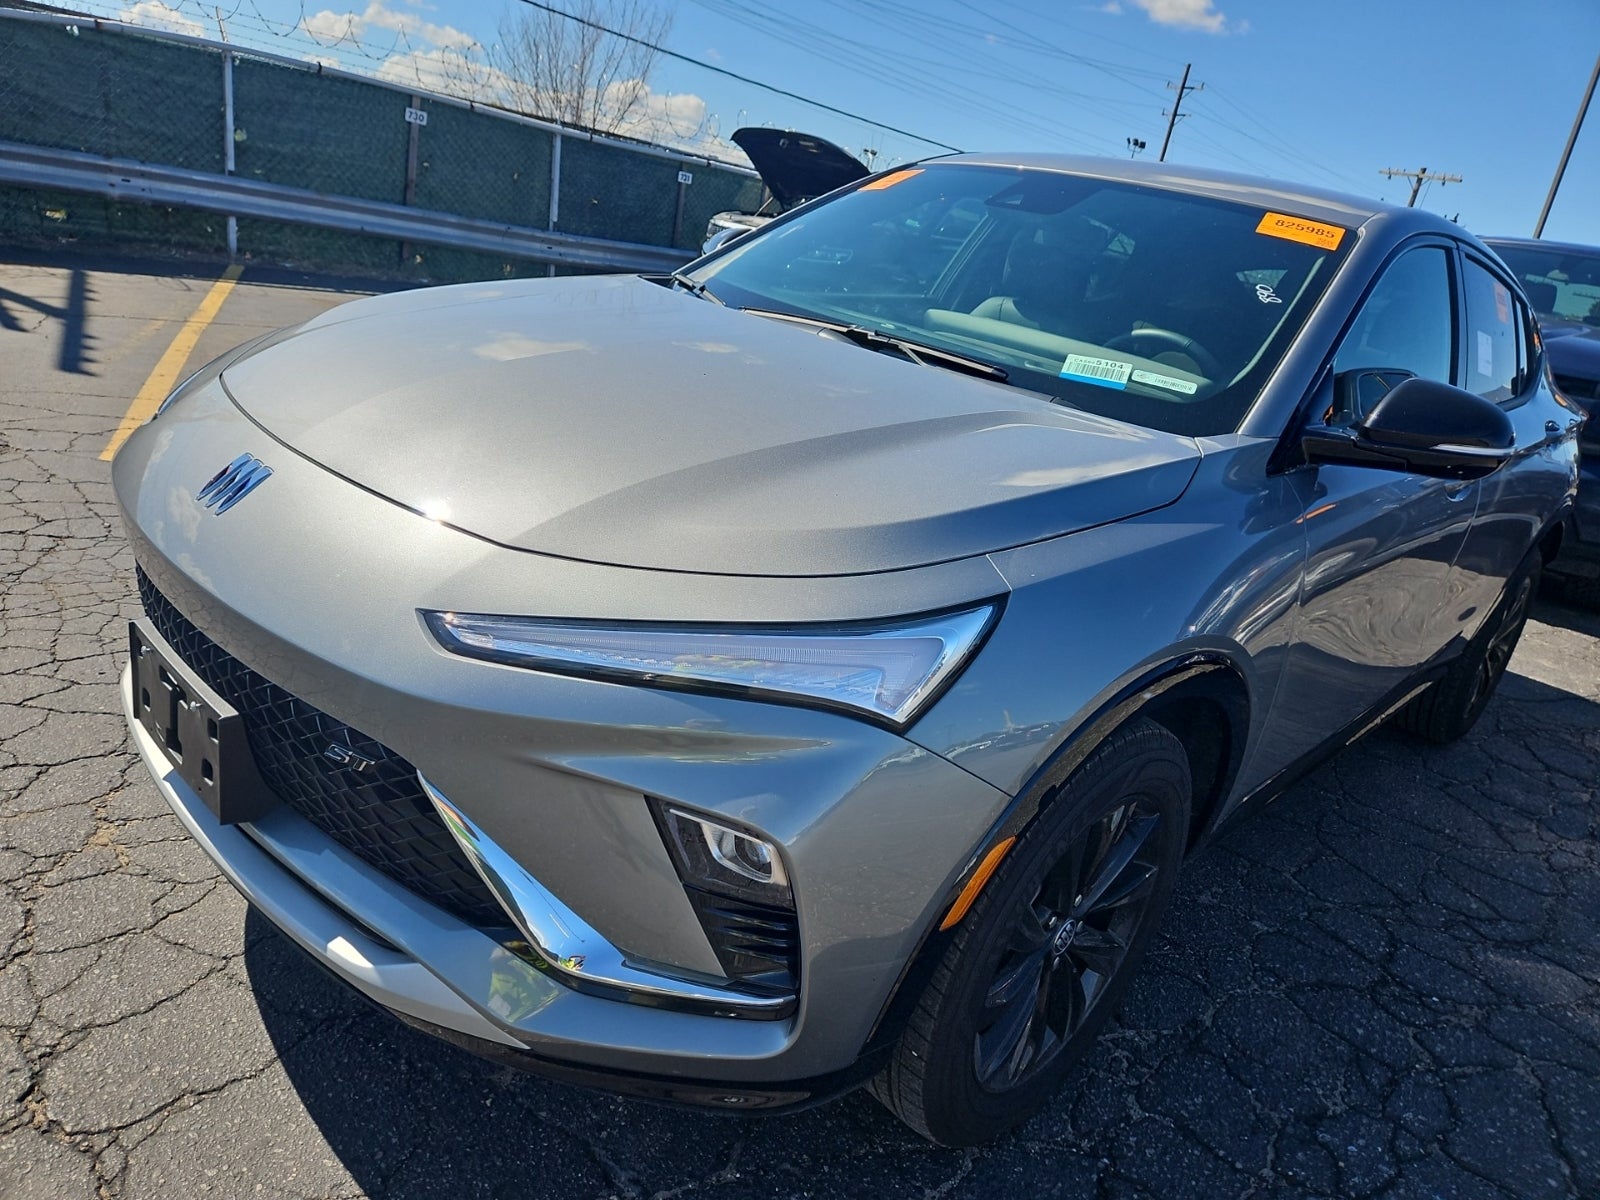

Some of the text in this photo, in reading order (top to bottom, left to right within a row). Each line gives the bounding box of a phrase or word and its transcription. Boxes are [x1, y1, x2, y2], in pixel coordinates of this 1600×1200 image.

[408, 110, 425, 122] 730
[1275, 219, 1336, 239] 825985
[324, 743, 376, 772] ST
